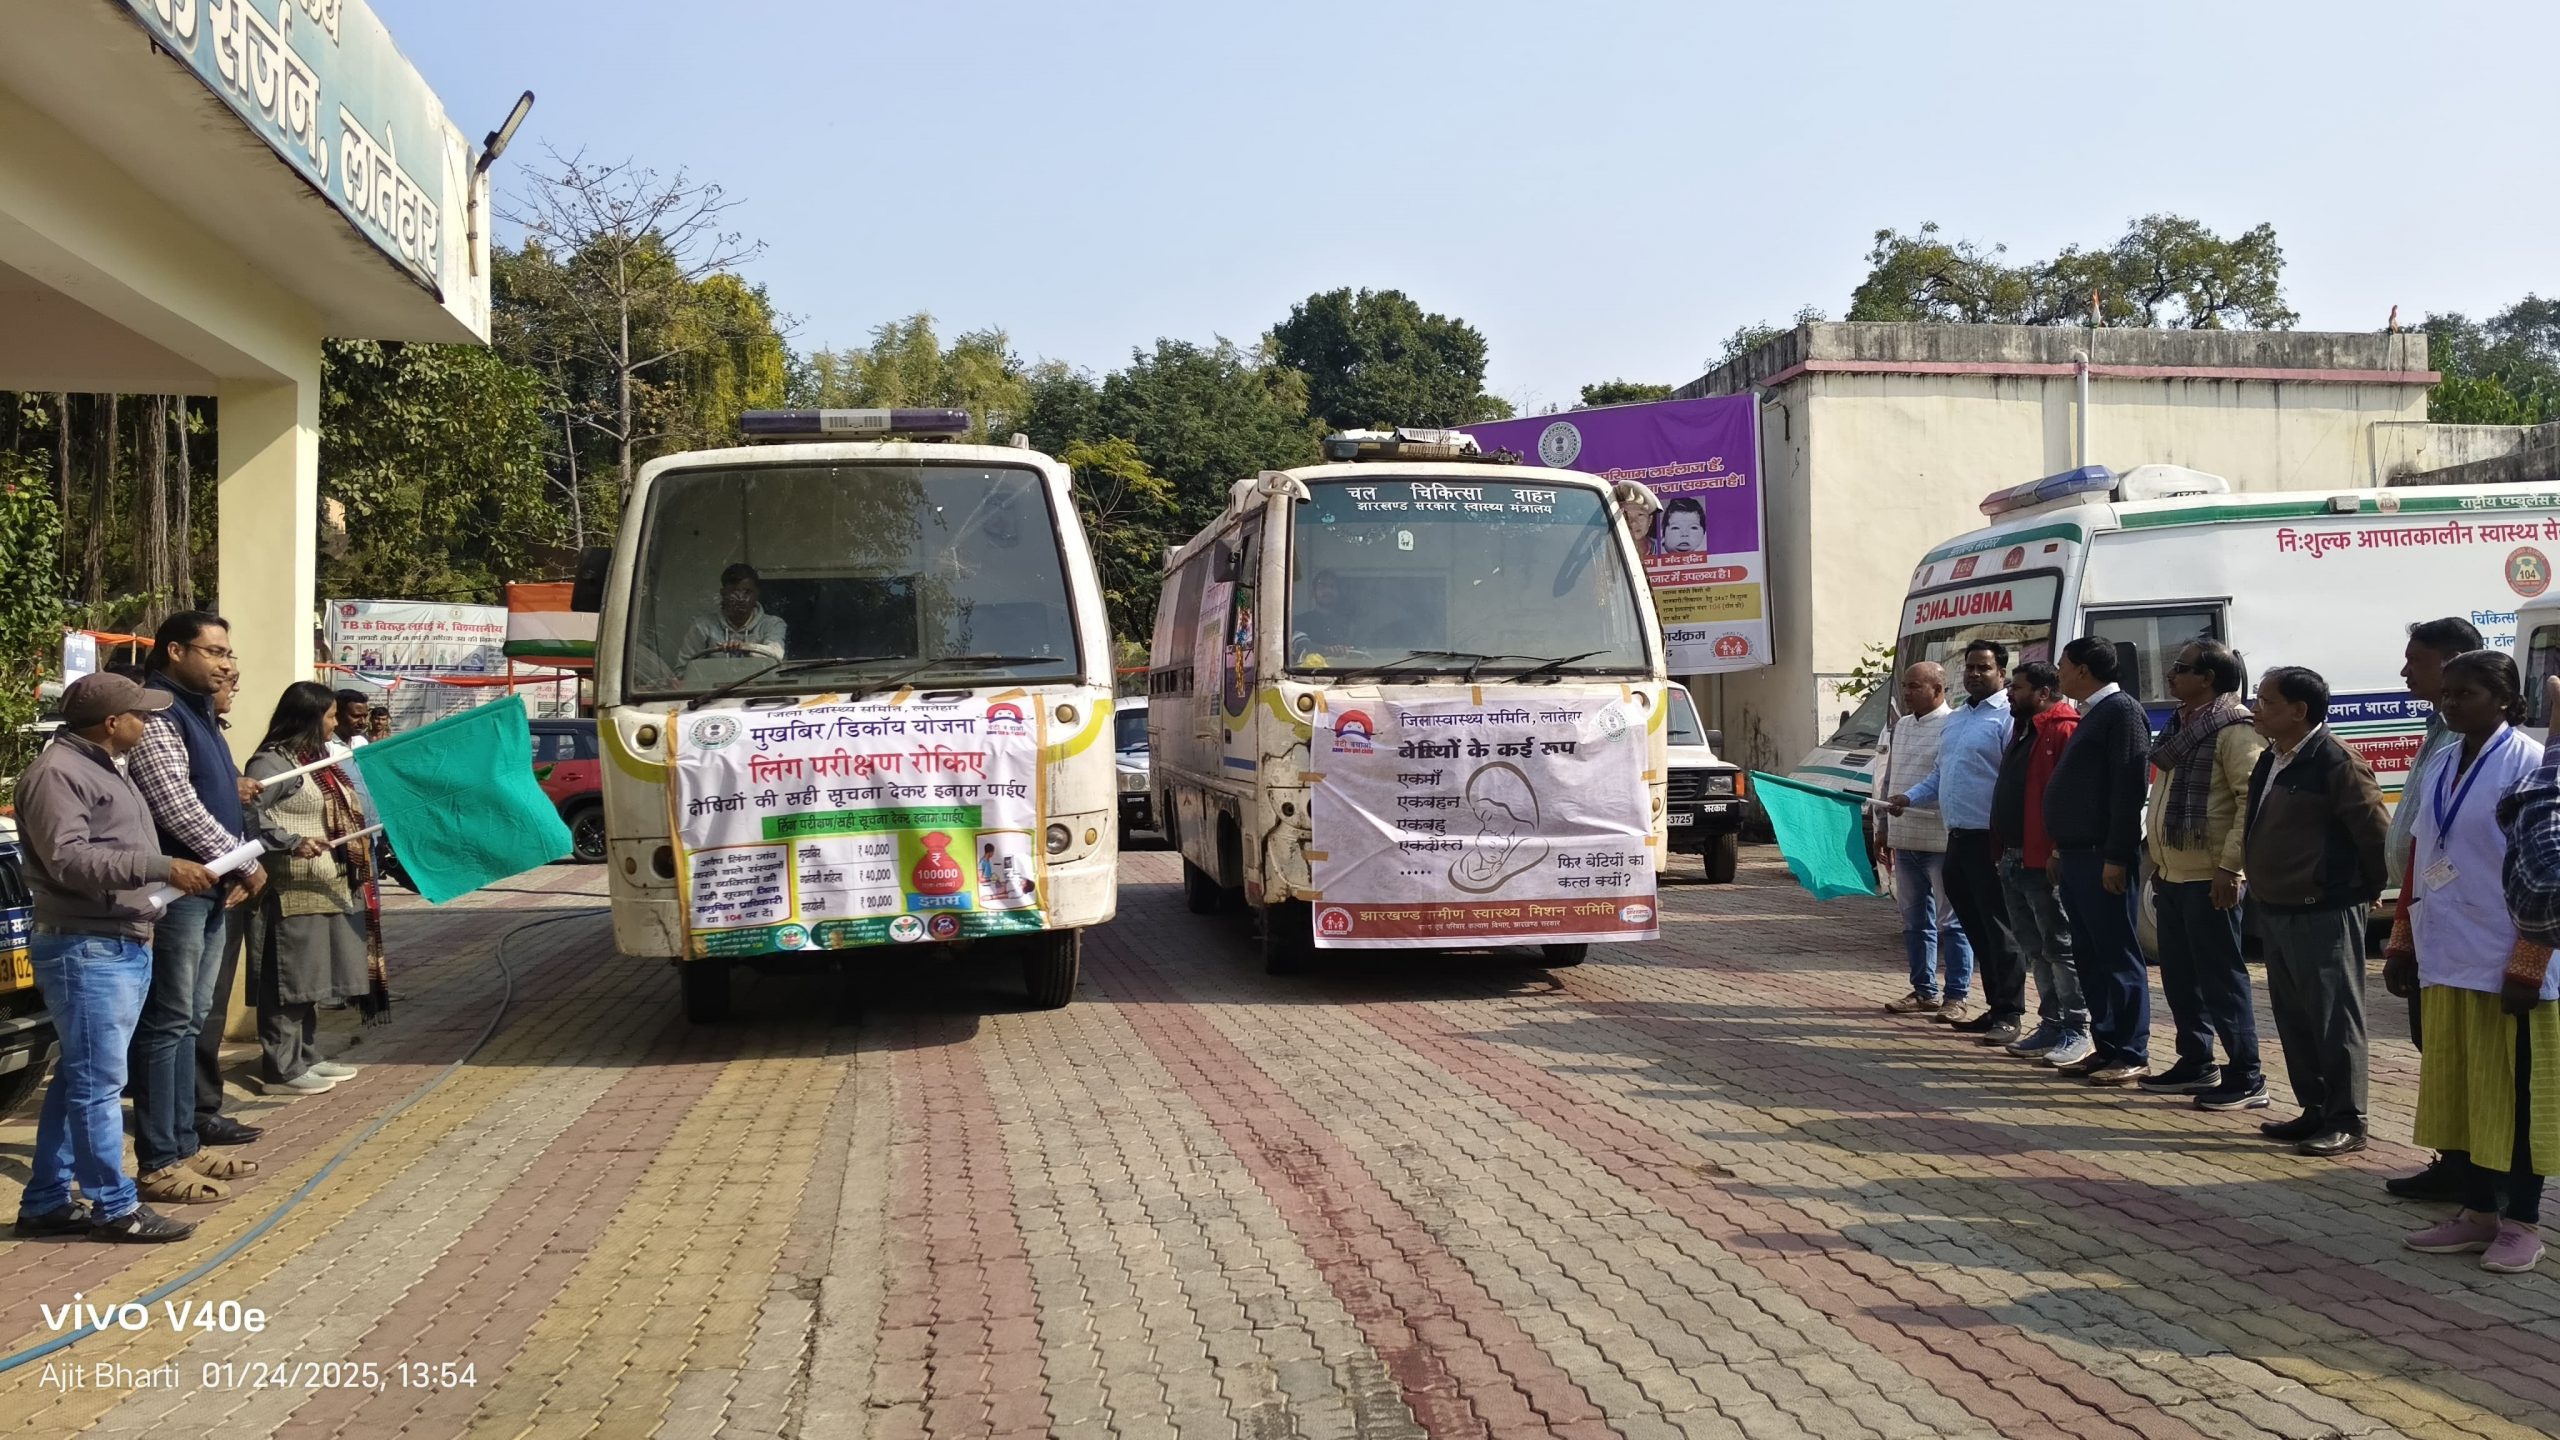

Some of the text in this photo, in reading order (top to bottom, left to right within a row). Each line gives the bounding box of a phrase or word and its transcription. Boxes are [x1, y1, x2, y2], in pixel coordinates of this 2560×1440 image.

[340, 102, 439, 275] लातेहार
[1346, 482, 1557, 504] चल चिकित्सा वाहन
[1661, 482, 1680, 493] जा
[1682, 477, 1724, 491] सकता
[1356, 502, 1552, 514] झारखण्ड सरकार स्वास्थ्य मंत्रालय
[2357, 520, 2474, 548] आपातकालीन
[2478, 523, 2539, 543] स्वास्थ्य
[2520, 570, 2536, 580] 104
[341, 621, 358, 630] TB
[2471, 610, 2518, 625] चिकित्स
[2364, 700, 2401, 715] भारत
[1487, 708, 1536, 725] समिति,
[1539, 707, 1583, 724] लातेहार
[911, 714, 976, 735] योजना
[1467, 738, 1490, 758] के
[1496, 736, 1535, 758] कई
[1540, 741, 1577, 755] रूप
[748, 744, 987, 784] लिंग परीक्षण रोकिए
[2376, 755, 2401, 769] सेवा
[753, 789, 779, 808] की
[785, 785, 820, 806] सही
[826, 786, 884, 807] सूचना
[887, 782, 928, 799] देकर
[934, 784, 981, 799] इनाम
[987, 780, 1027, 799] पाईए
[1396, 796, 1460, 812] एकबहन
[1704, 803, 1727, 813] सरकार
[865, 843, 889, 856] 40,000
[1558, 852, 1644, 869] फिर बेटियों का
[866, 869, 891, 882] 40,000
[918, 868, 958, 880] 100000
[1558, 872, 1632, 889] कत्ल क्यों?
[1360, 910, 1421, 922] झारखण्ड
[1473, 906, 1521, 920] स्वास्थ्य
[1528, 904, 1567, 918] मिशन
[1573, 902, 1616, 916] समिति
